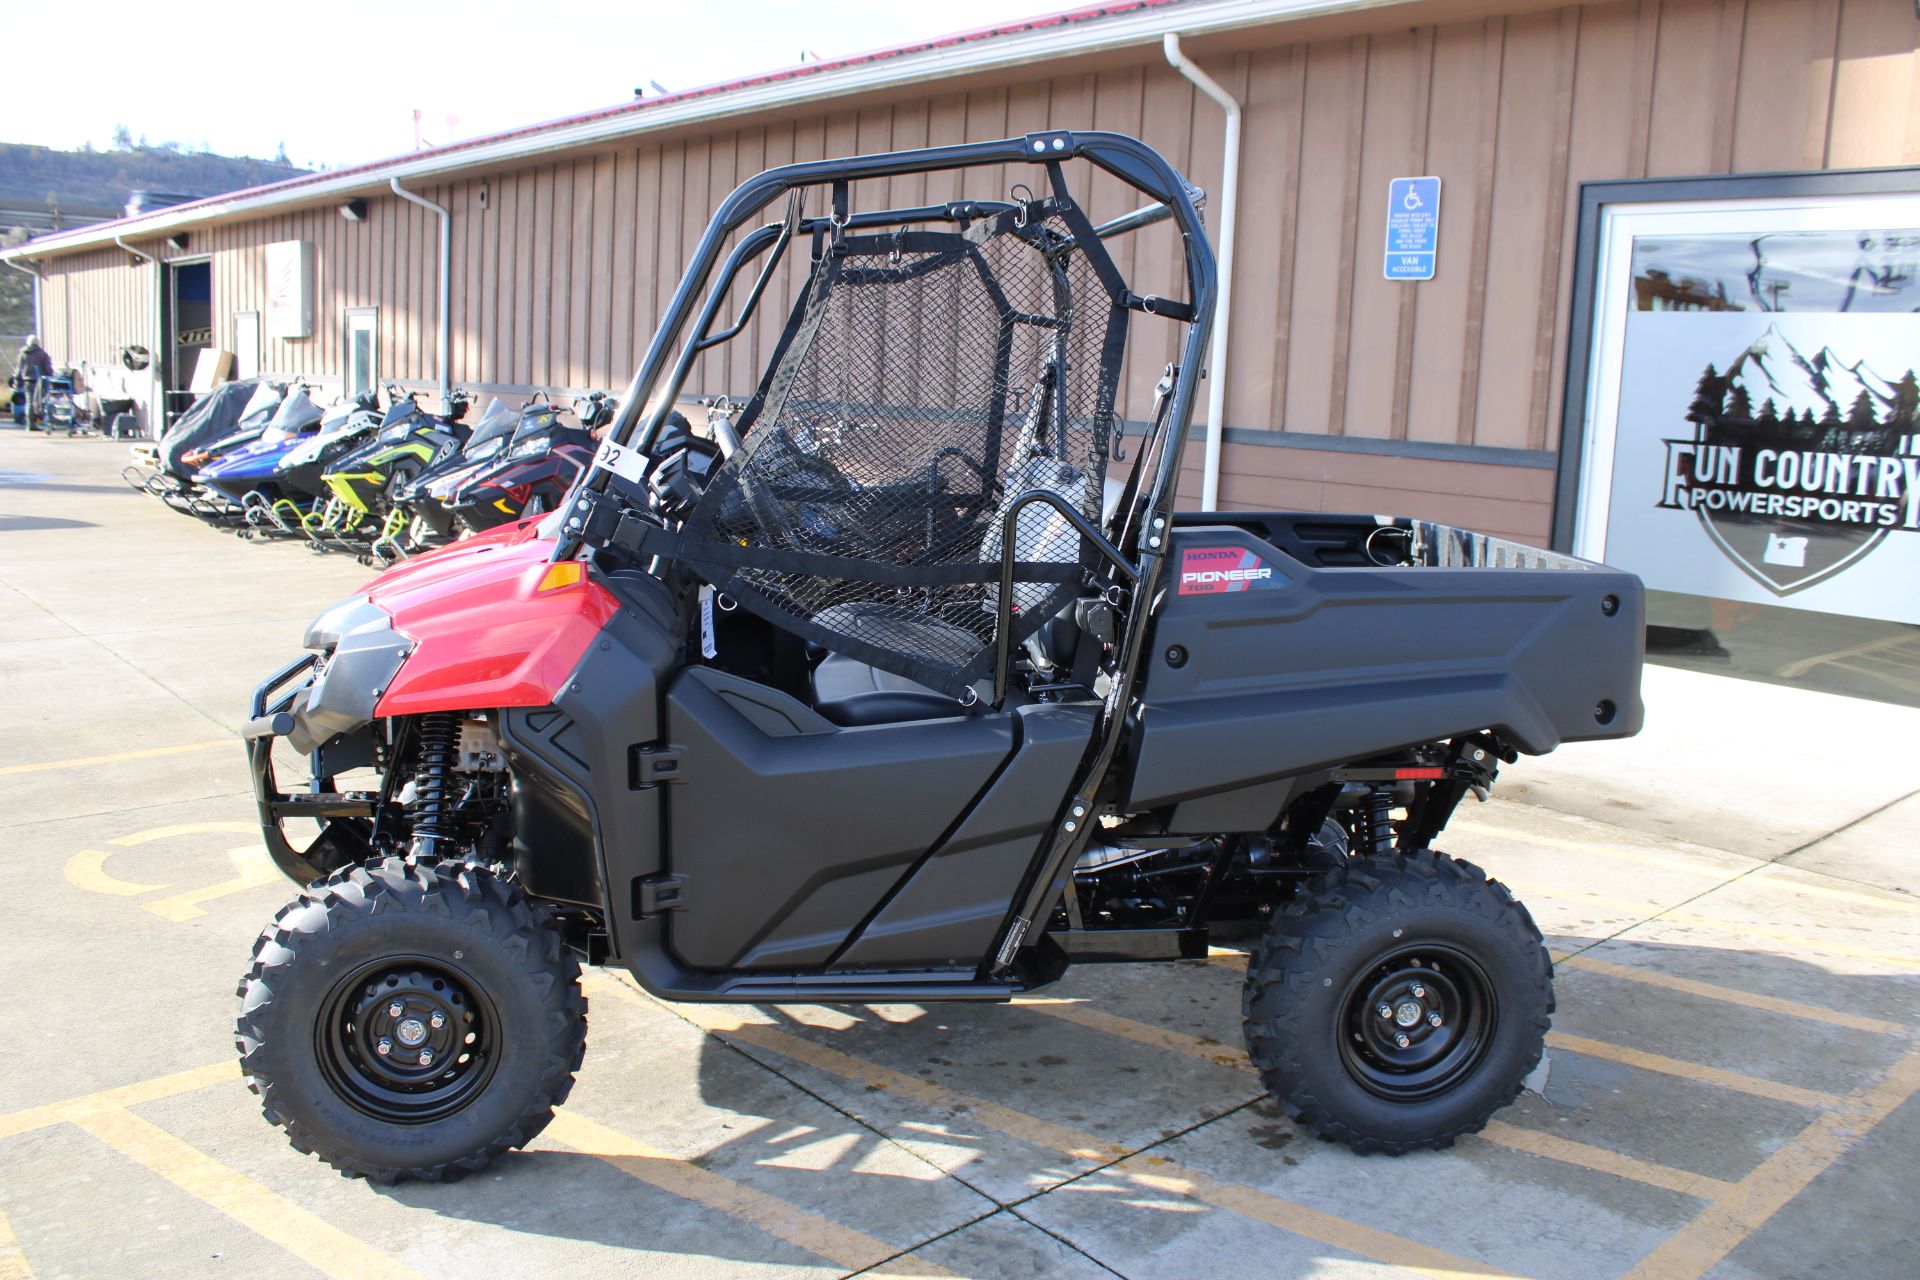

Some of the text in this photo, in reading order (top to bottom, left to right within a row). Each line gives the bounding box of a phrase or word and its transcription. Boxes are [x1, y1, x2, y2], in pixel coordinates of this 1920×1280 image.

[1402, 256, 1419, 265] VAN
[1660, 441, 1920, 528] FUN COUNTRY
[1691, 488, 1898, 526] POWERSPORTS
[1186, 551, 1238, 561] HONDA
[1183, 568, 1272, 583] PIONEER
